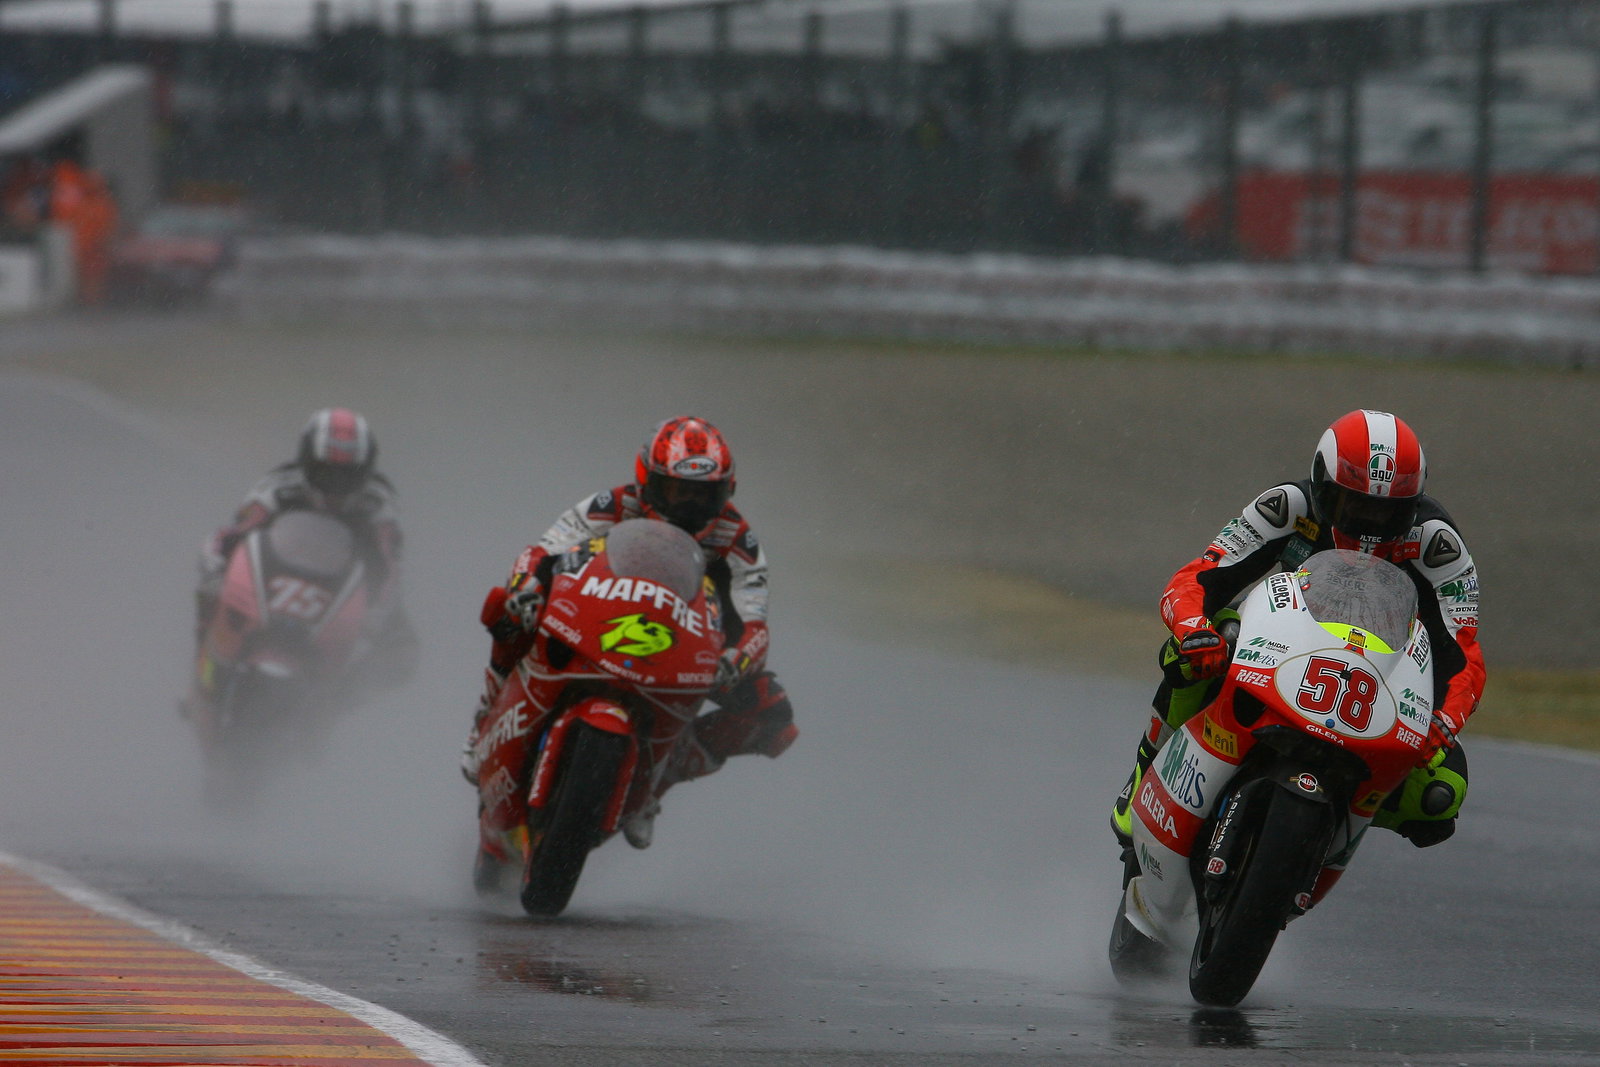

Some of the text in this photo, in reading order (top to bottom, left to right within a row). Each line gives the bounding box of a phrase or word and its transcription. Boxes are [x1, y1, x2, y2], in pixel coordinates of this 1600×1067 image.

[1371, 470, 1393, 482] agv
[580, 576, 704, 638] MAPFRE
[1267, 640, 1290, 650] MIDAC
[1296, 655, 1379, 733] 58
[1214, 734, 1234, 755] eni
[1306, 724, 1345, 746] GILERA
[1141, 781, 1179, 839] GILERA
[1213, 801, 1238, 852] DUNLOP
[1208, 858, 1224, 874] 58
